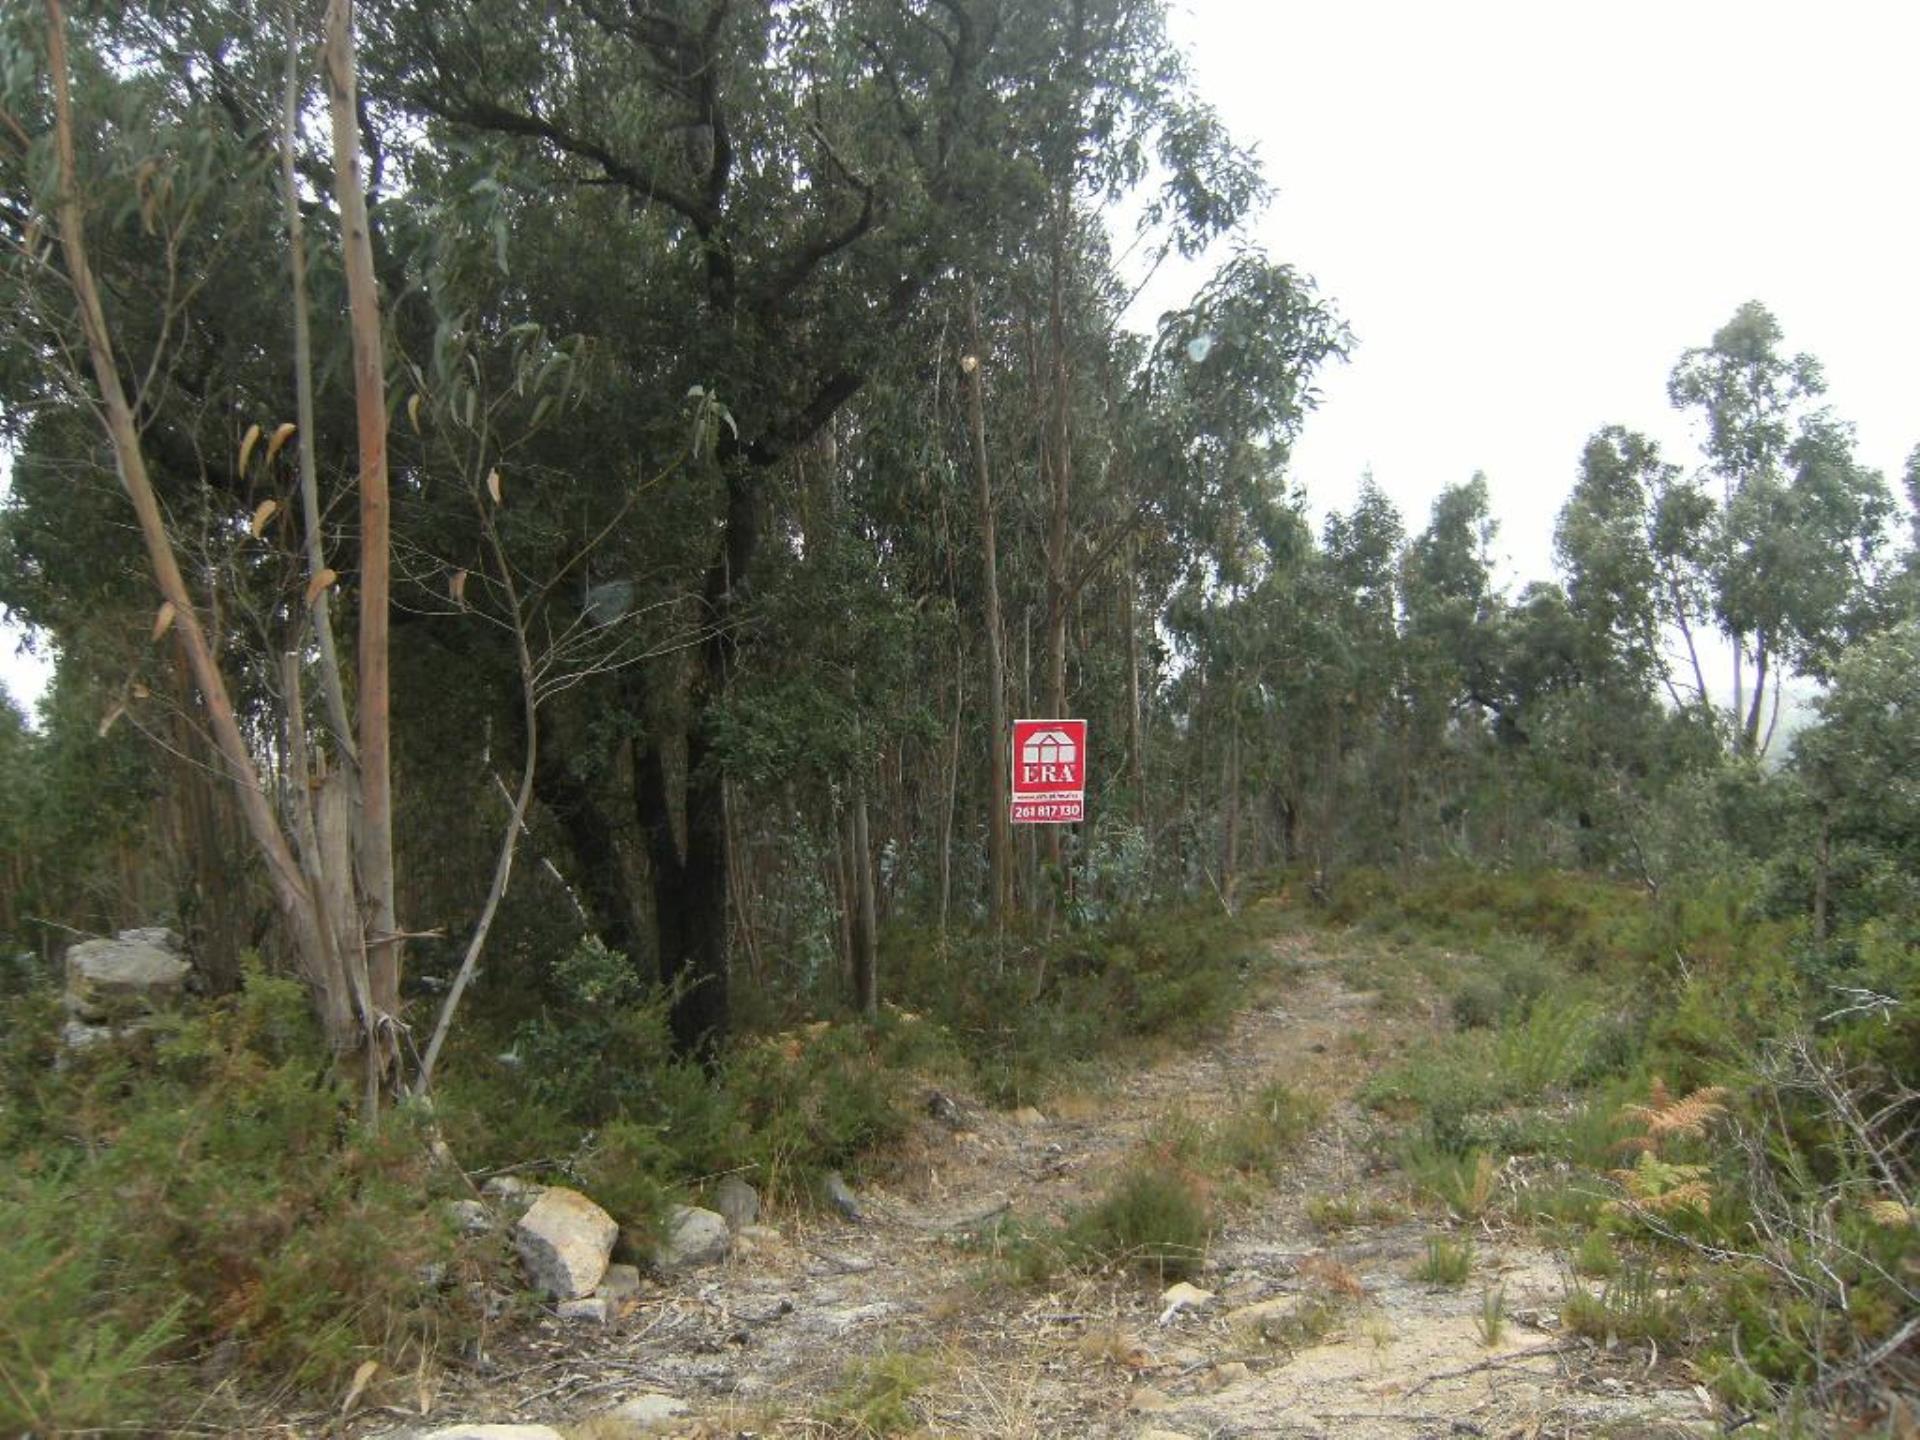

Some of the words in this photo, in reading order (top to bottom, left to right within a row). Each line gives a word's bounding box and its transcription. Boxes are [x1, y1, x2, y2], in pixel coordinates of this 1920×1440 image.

[1022, 764, 1075, 784] ERA
[1015, 806, 1035, 818] 261
[1038, 805, 1057, 817] 817
[1060, 804, 1080, 816] 130
